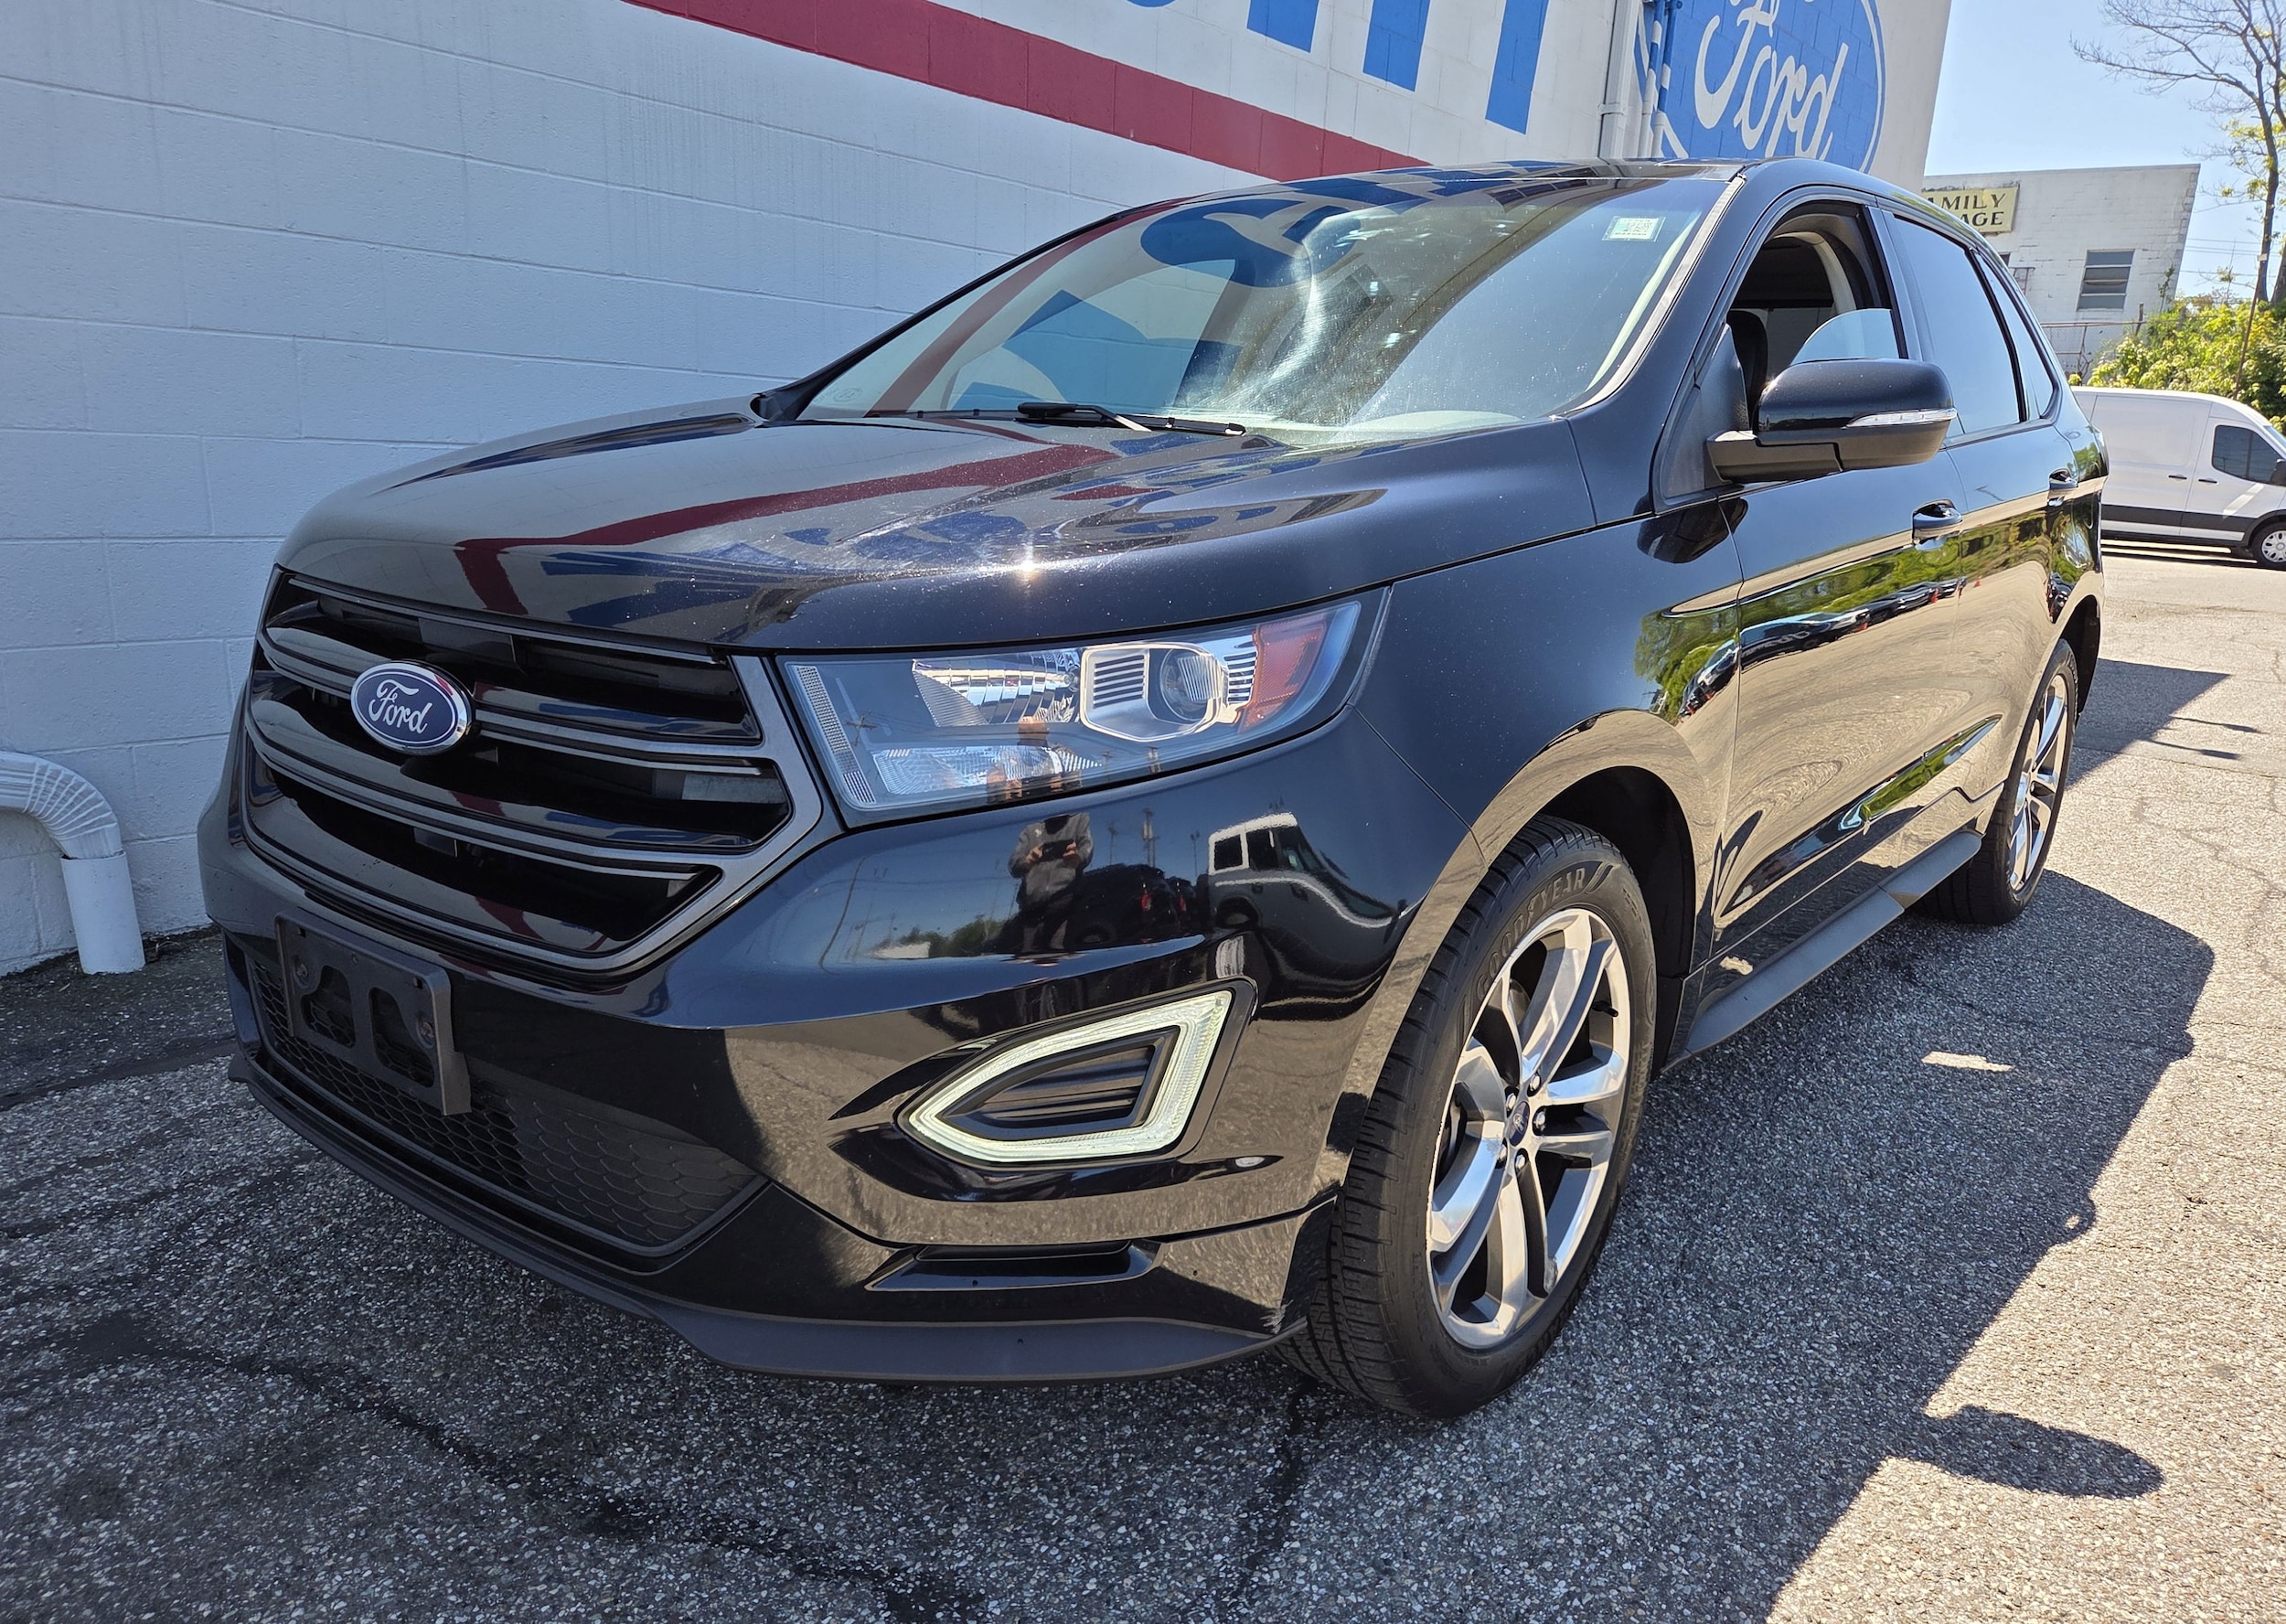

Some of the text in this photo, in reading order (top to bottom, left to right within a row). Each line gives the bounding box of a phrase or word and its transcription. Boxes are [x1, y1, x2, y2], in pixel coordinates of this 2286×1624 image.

[1694, 0, 1849, 161] Ford
[1925, 193, 2005, 210] MILY
[369, 679, 433, 733] Ford
[1476, 867, 1586, 1002] GOODYEAR
